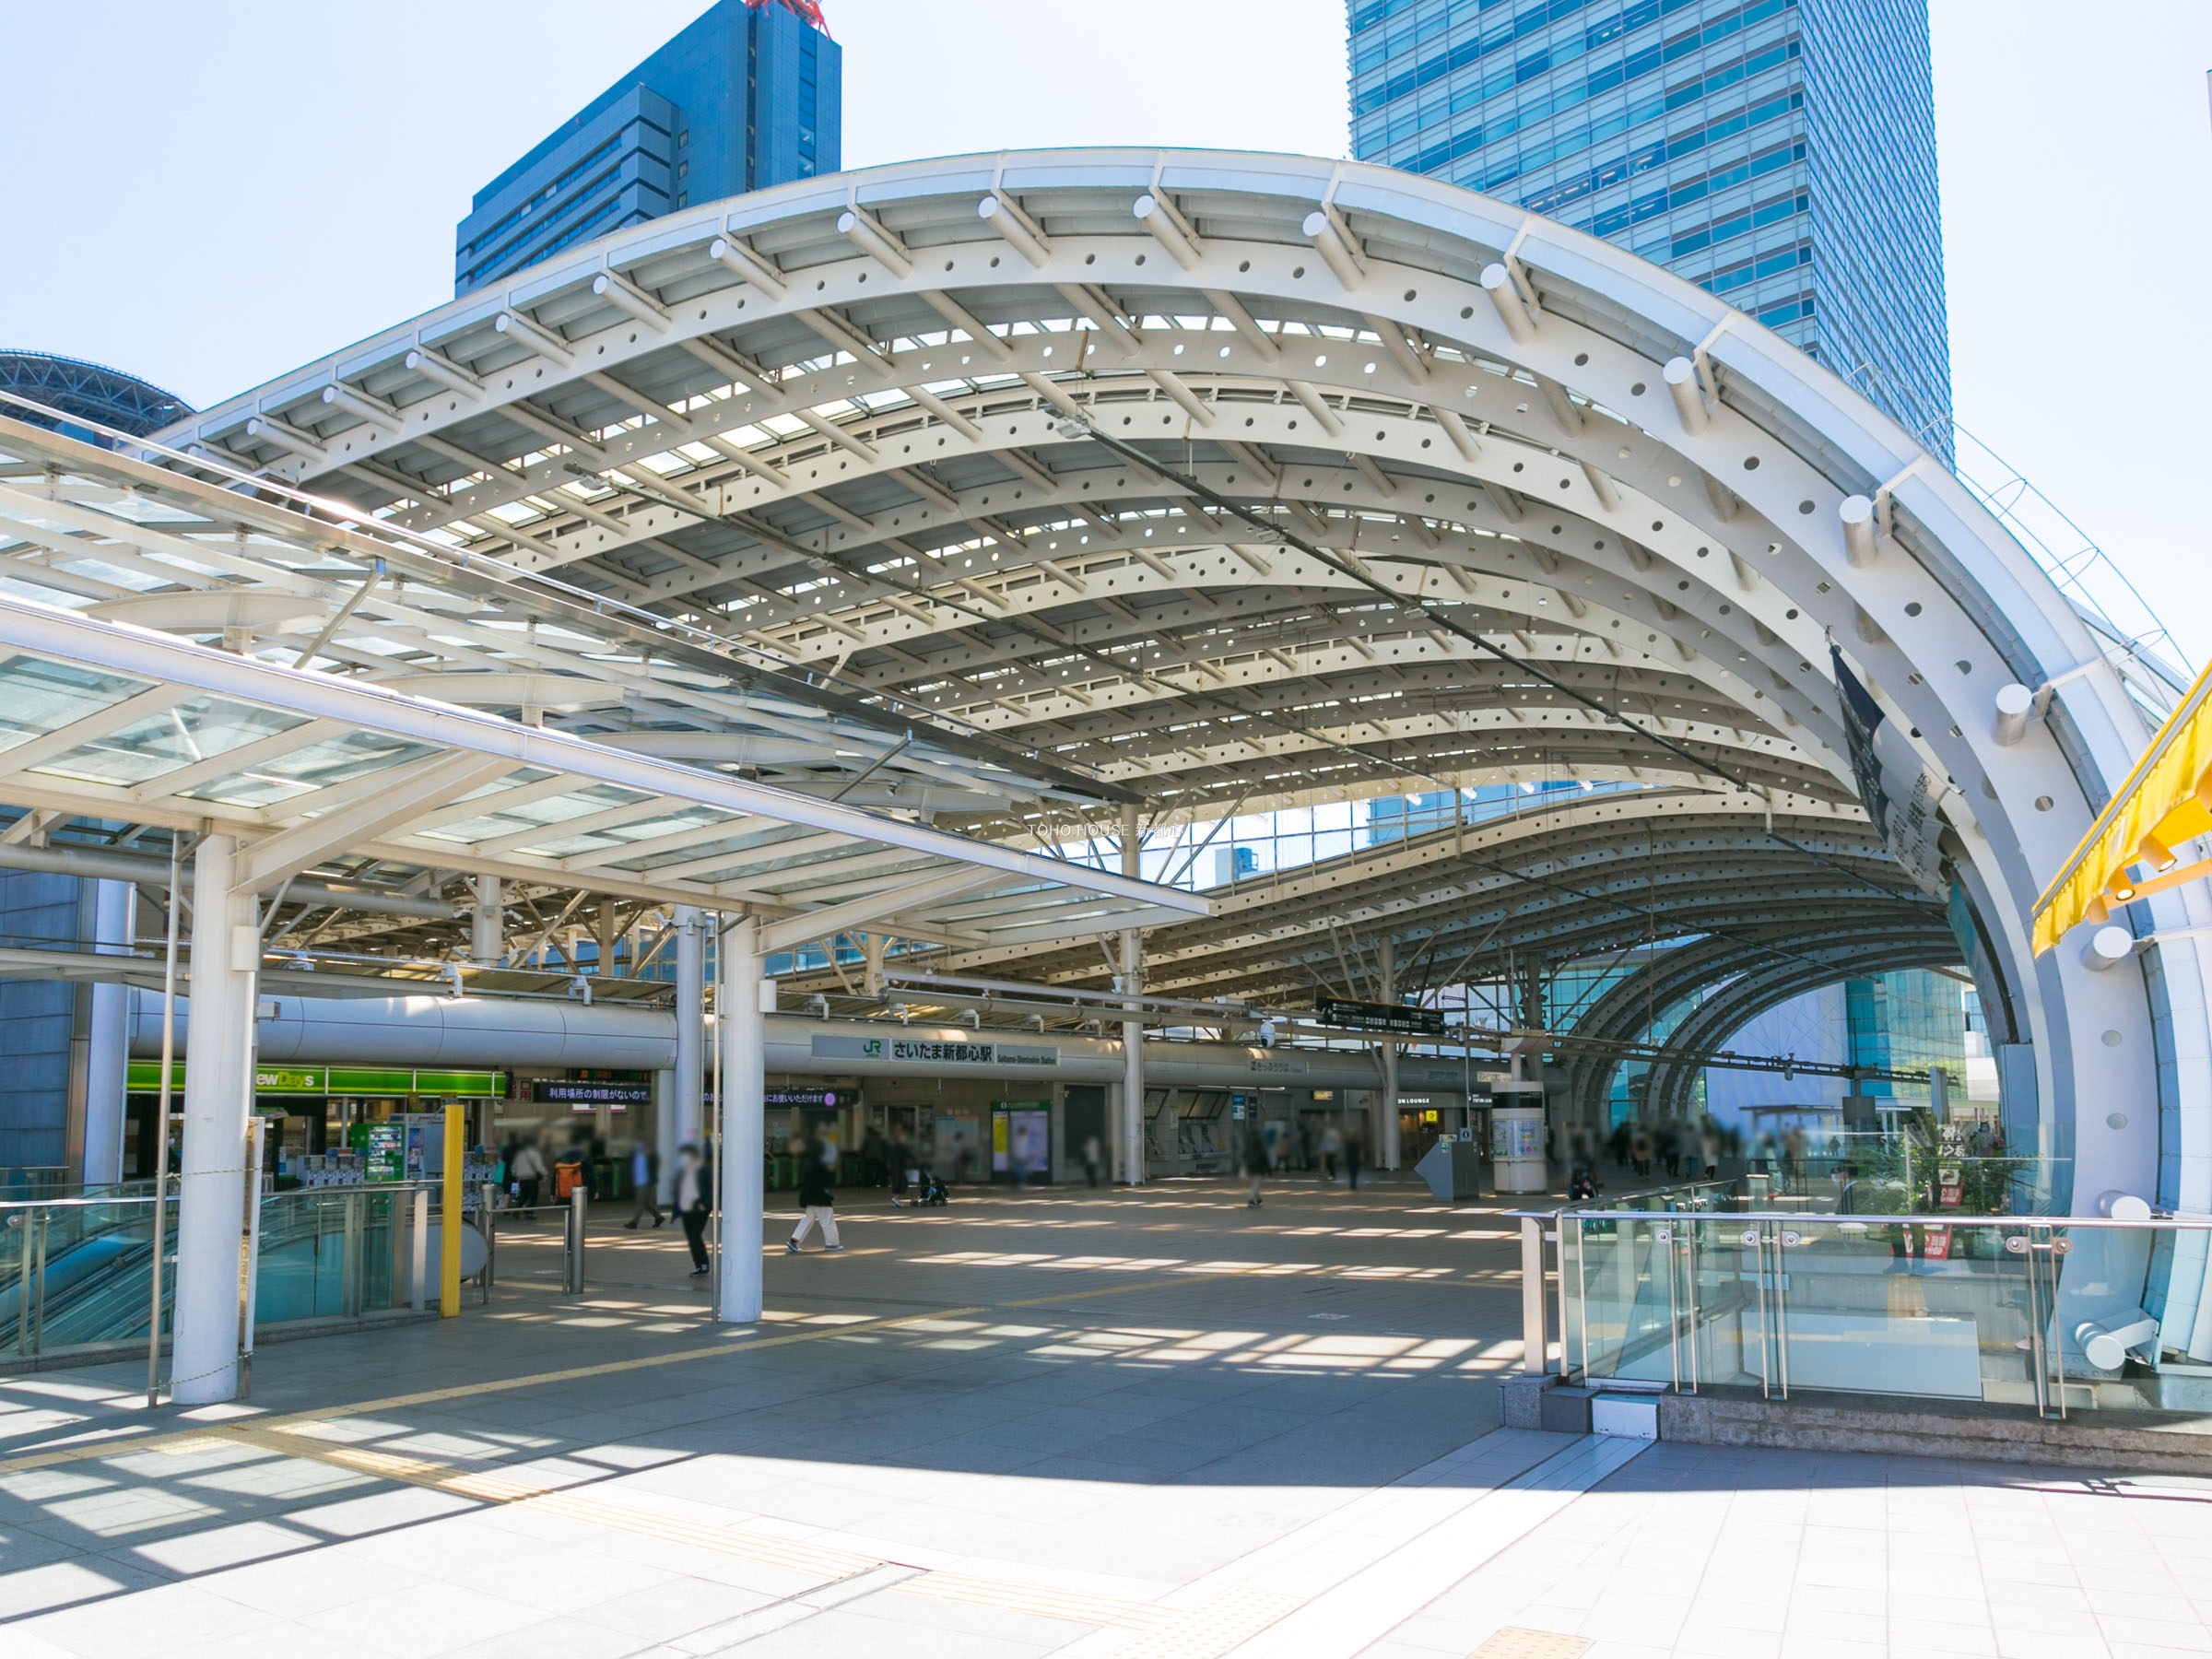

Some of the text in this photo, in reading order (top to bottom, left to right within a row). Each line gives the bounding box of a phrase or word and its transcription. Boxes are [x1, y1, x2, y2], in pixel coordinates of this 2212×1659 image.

[863, 1040, 881, 1053] JR
[894, 1041, 993, 1063] さいたま新都心駅
[255, 1072, 314, 1088] ewDays
